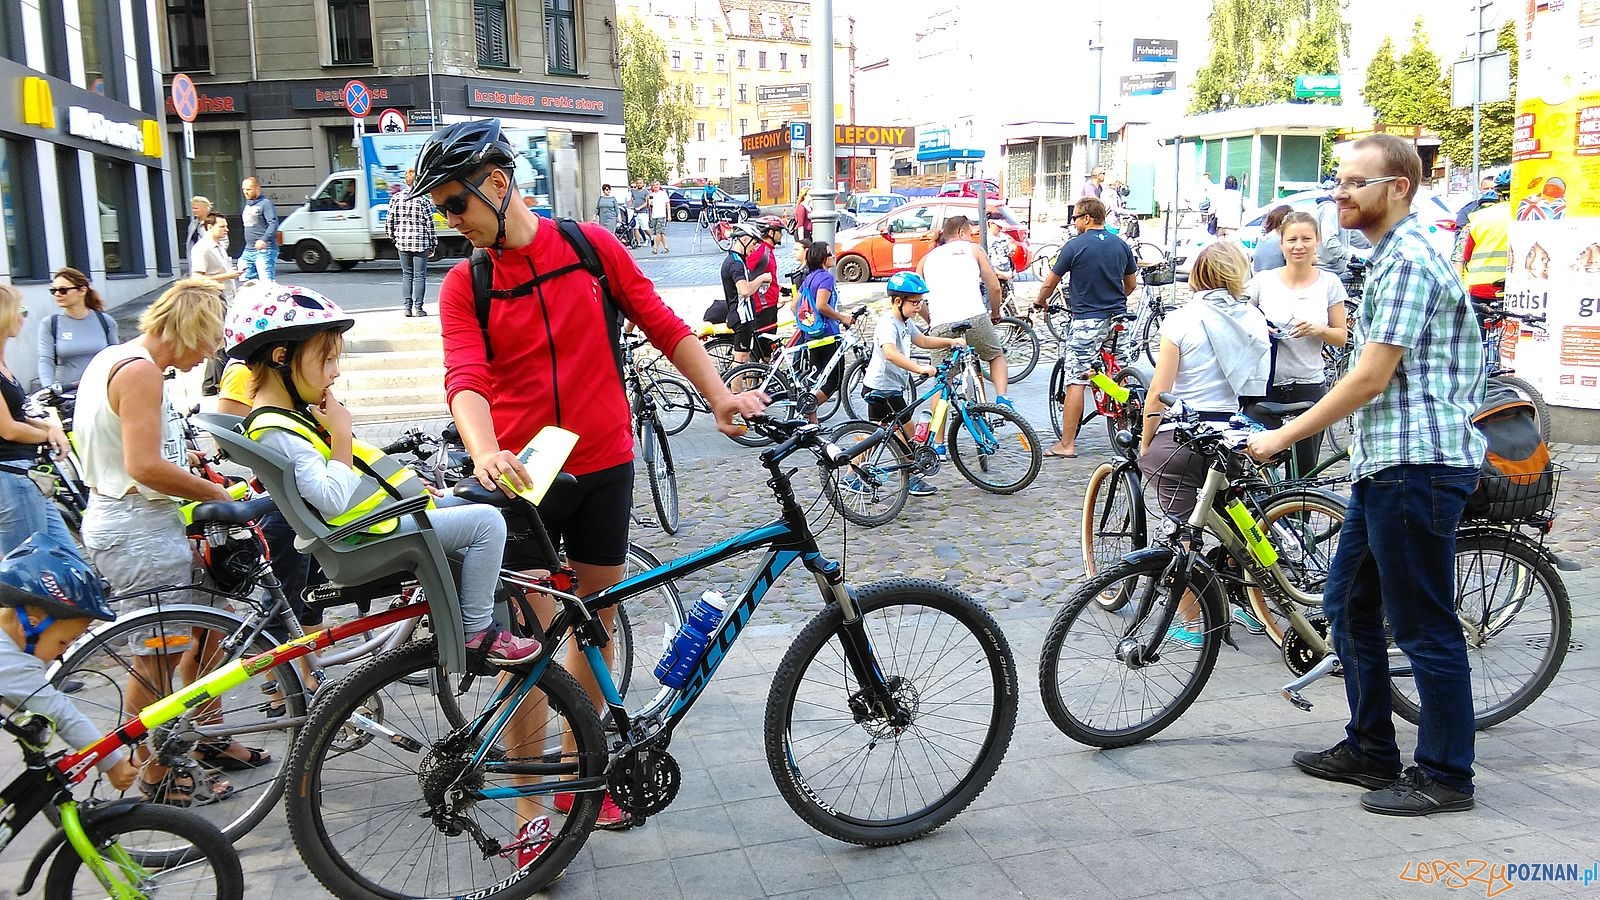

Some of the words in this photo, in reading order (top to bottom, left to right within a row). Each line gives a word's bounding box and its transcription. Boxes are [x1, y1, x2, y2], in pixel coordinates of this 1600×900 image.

[198, 93, 235, 112] hse
[315, 88, 345, 102] beat
[474, 89, 507, 104] beate
[508, 92, 535, 106] uhse
[541, 96, 574, 109] erotic
[575, 98, 604, 111] store
[742, 132, 781, 151] TELEFONY
[836, 126, 907, 146] LEFONY
[681, 553, 780, 701] SCOTT
